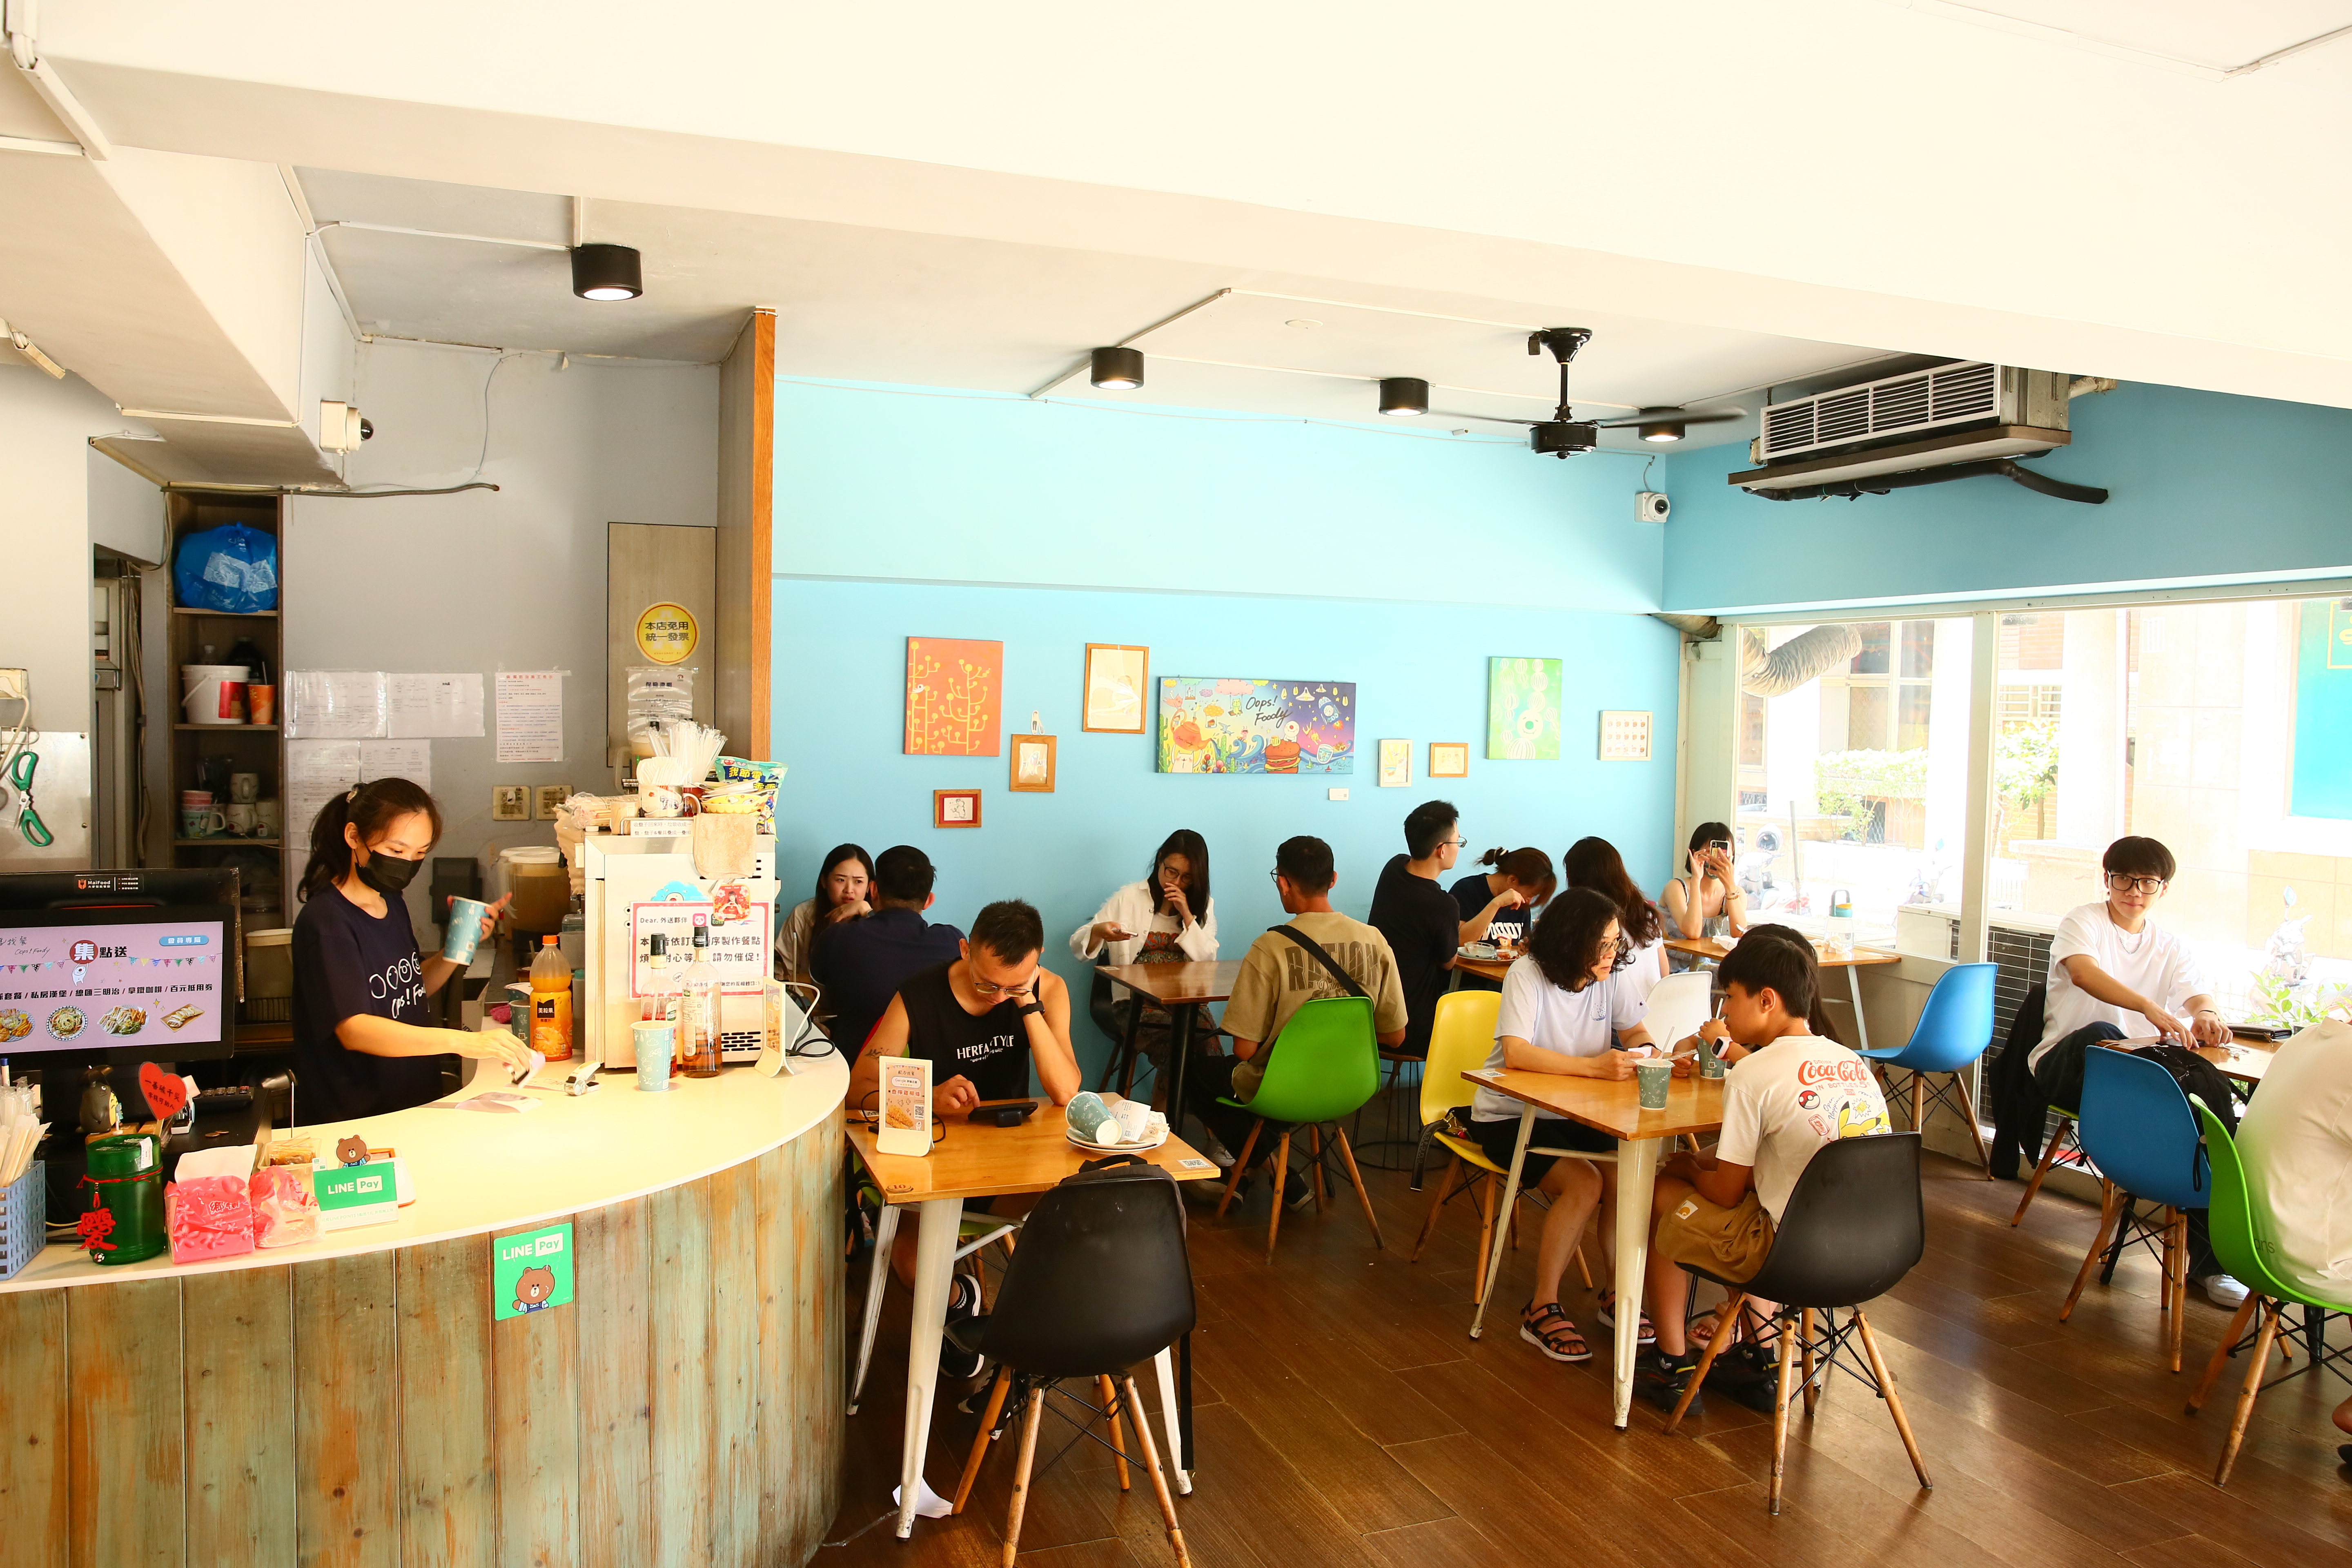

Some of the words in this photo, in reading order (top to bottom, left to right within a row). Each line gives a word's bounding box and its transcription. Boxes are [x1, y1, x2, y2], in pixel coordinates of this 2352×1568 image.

[645, 622, 688, 630] 本店免用
[645, 633, 689, 641] 統一發票
[1246, 695, 1278, 712] Oops!
[1254, 707, 1293, 728] Foody
[31, 990, 67, 999] 私房漢堡
[75, 988, 120, 996] 總匯三明治
[170, 984, 213, 992] 百元抵用券
[1823, 1096, 1835, 1111] Open
[328, 1182, 355, 1195] LINE
[360, 1180, 379, 1189] Pay
[503, 1243, 533, 1261] LINE
[539, 1239, 560, 1252] Pay
